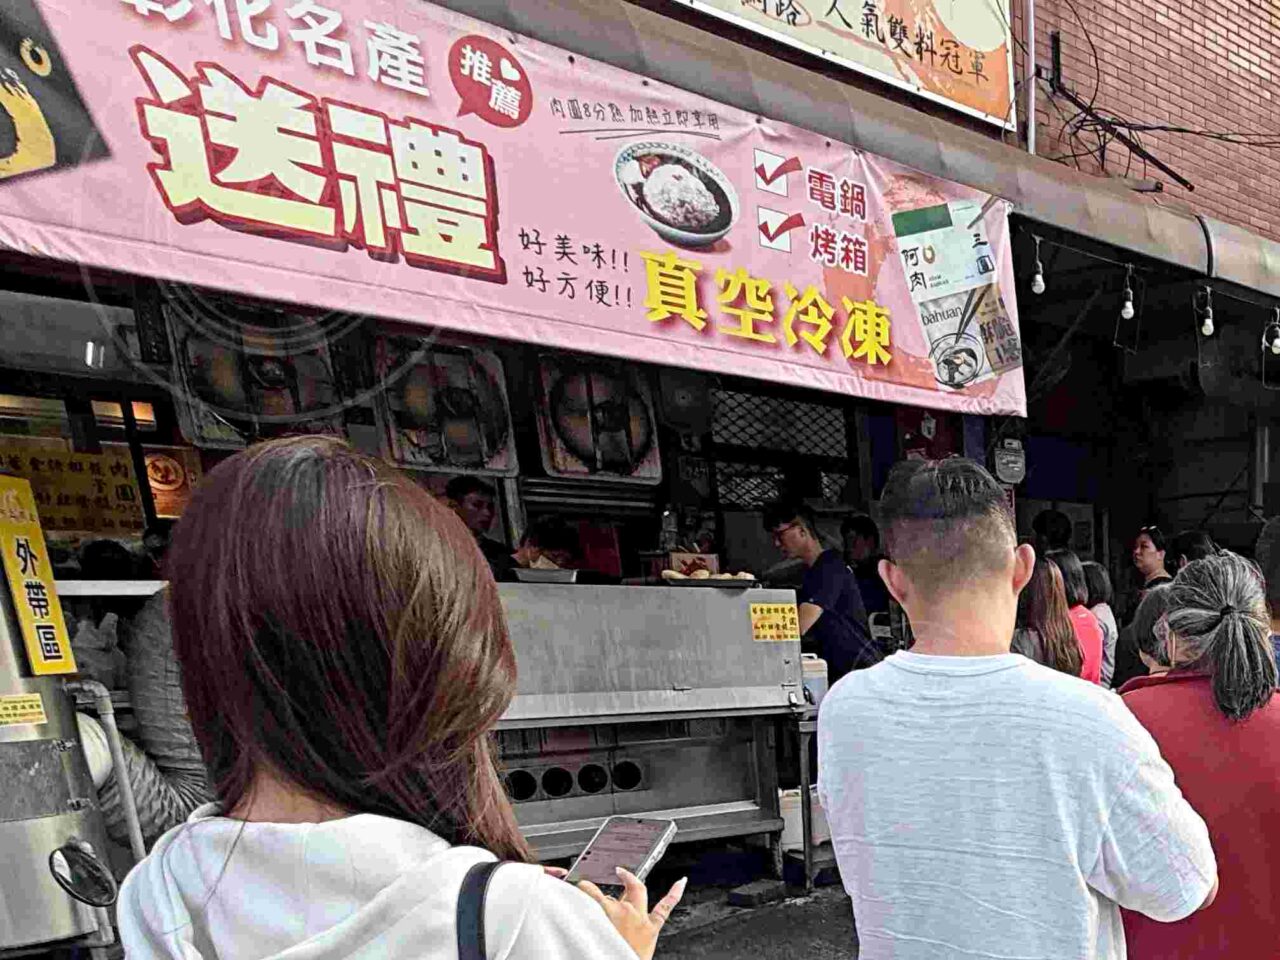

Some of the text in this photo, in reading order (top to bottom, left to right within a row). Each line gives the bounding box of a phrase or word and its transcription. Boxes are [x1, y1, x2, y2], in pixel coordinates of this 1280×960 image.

[460, 44, 522, 120] 推薦
[130, 46, 506, 282] 送禮
[807, 168, 867, 222] 電鍋
[518, 227, 629, 273] 好美味!!
[808, 224, 869, 277] 烤箱
[522, 265, 632, 308] 好方便!!
[640, 250, 893, 367] 真空冷凍
[921, 304, 964, 326] bahuan
[14, 536, 63, 661] 外帶區
